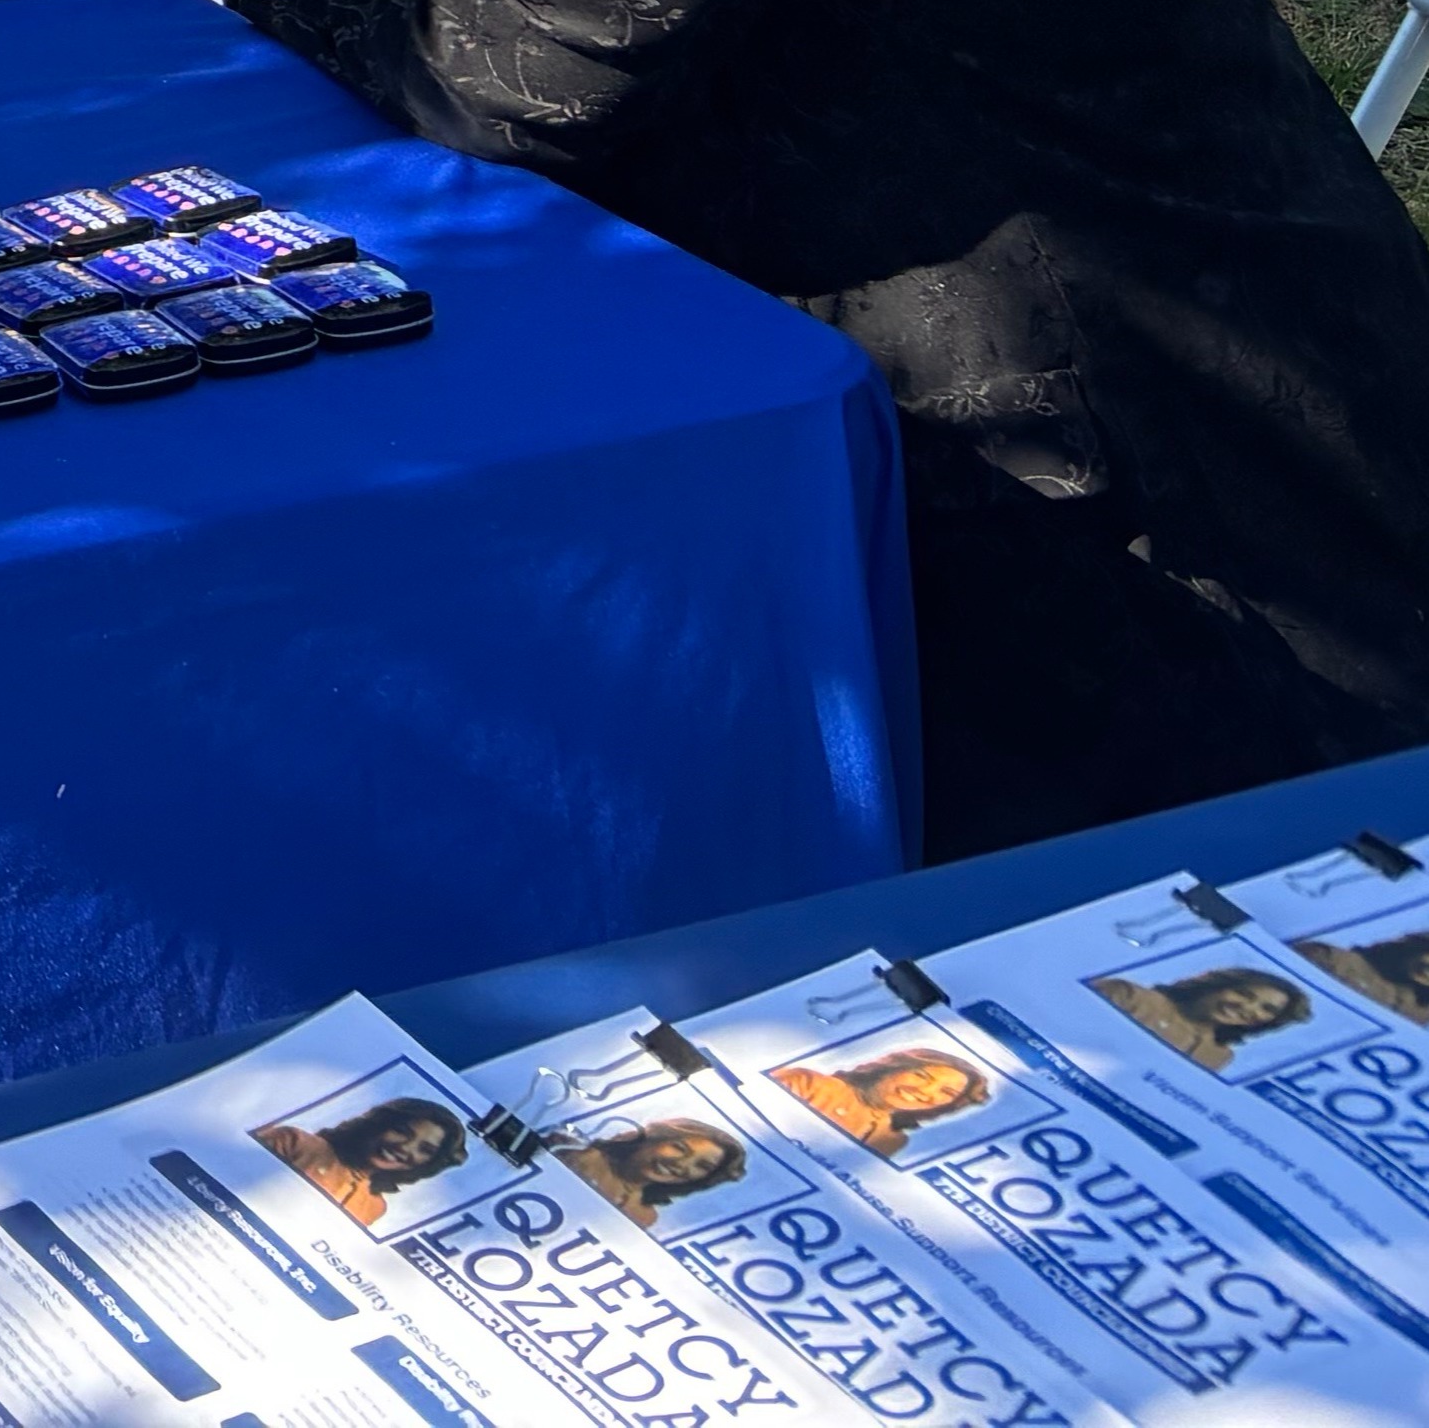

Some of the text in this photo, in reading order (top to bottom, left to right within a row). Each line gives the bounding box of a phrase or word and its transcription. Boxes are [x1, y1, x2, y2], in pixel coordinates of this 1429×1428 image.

[120, 239, 191, 280] Prepare
[237, 210, 314, 254] Prepare
[931, 1176, 972, 1206] 7TH
[965, 1203, 1047, 1265] DISTRICT
[1207, 1107, 1295, 1174] Support
[82, 1277, 102, 1299] for
[310, 1239, 394, 1312] Disability
[392, 1313, 492, 1400] Resources
[409, 1249, 445, 1278] 7TH
[437, 1273, 514, 1337] DISTRICT
[493, 1192, 798, 1417] QUETCY
[769, 1207, 1072, 1428] QUETCY
[839, 1171, 894, 1222] Abuse
[895, 1218, 976, 1286] Support
[972, 1284, 1089, 1378] Resources
[944, 1145, 1259, 1385] LOZADA
[1020, 1127, 1350, 1351] QUETCY
[689, 1225, 938, 1421] LOZAD
